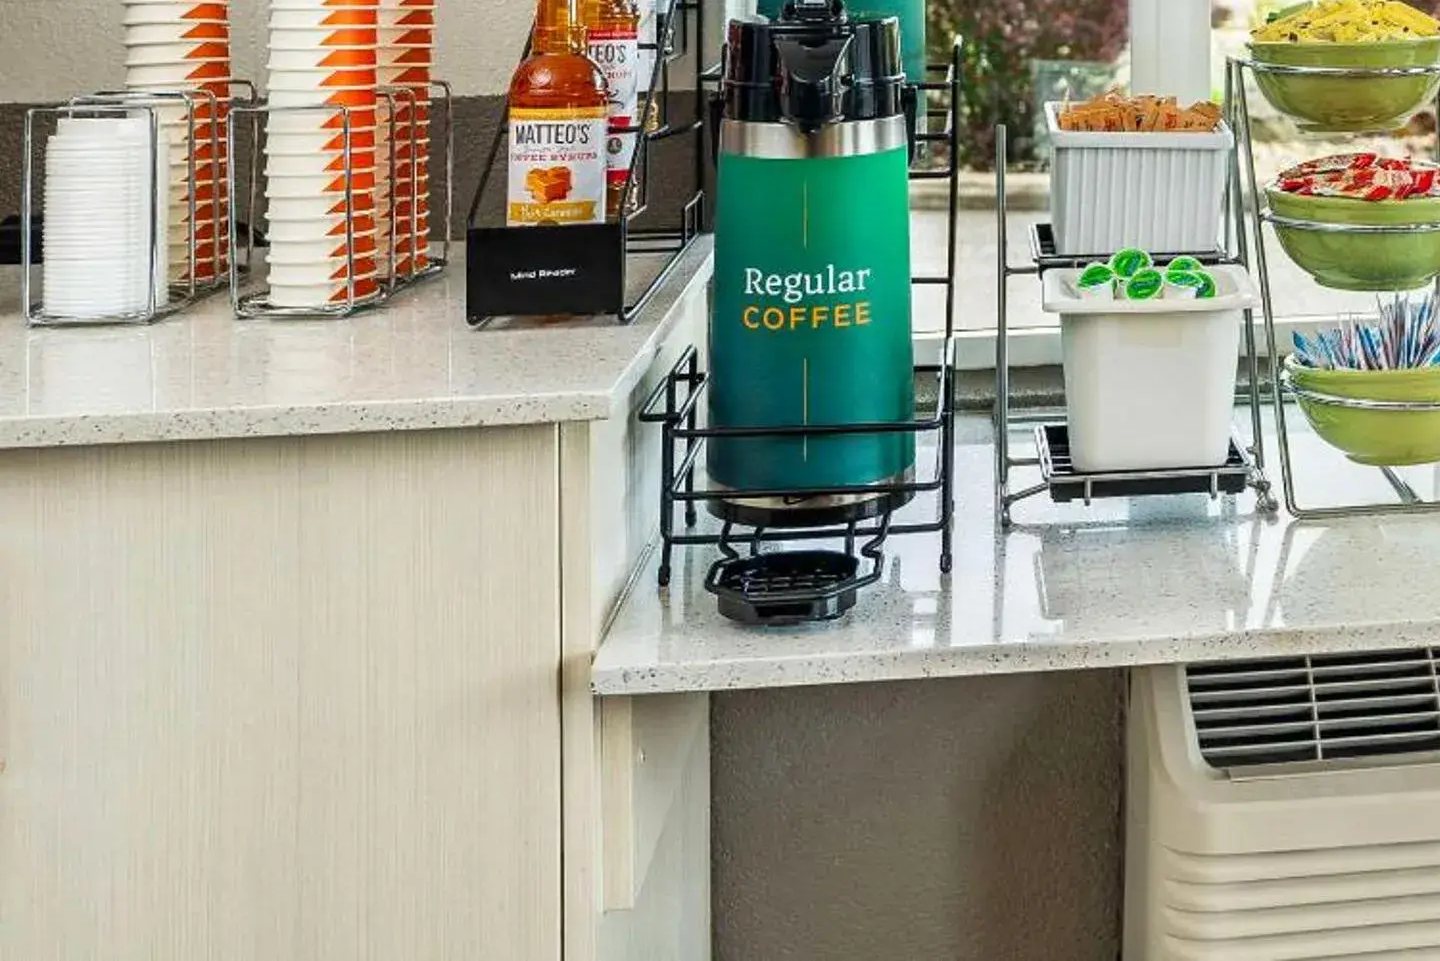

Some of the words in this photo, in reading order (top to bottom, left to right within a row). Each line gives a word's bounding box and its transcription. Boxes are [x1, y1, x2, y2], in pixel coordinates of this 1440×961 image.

[516, 124, 592, 145] MATTEO'S
[744, 264, 872, 303] Regular
[742, 302, 873, 330] COFFEE
